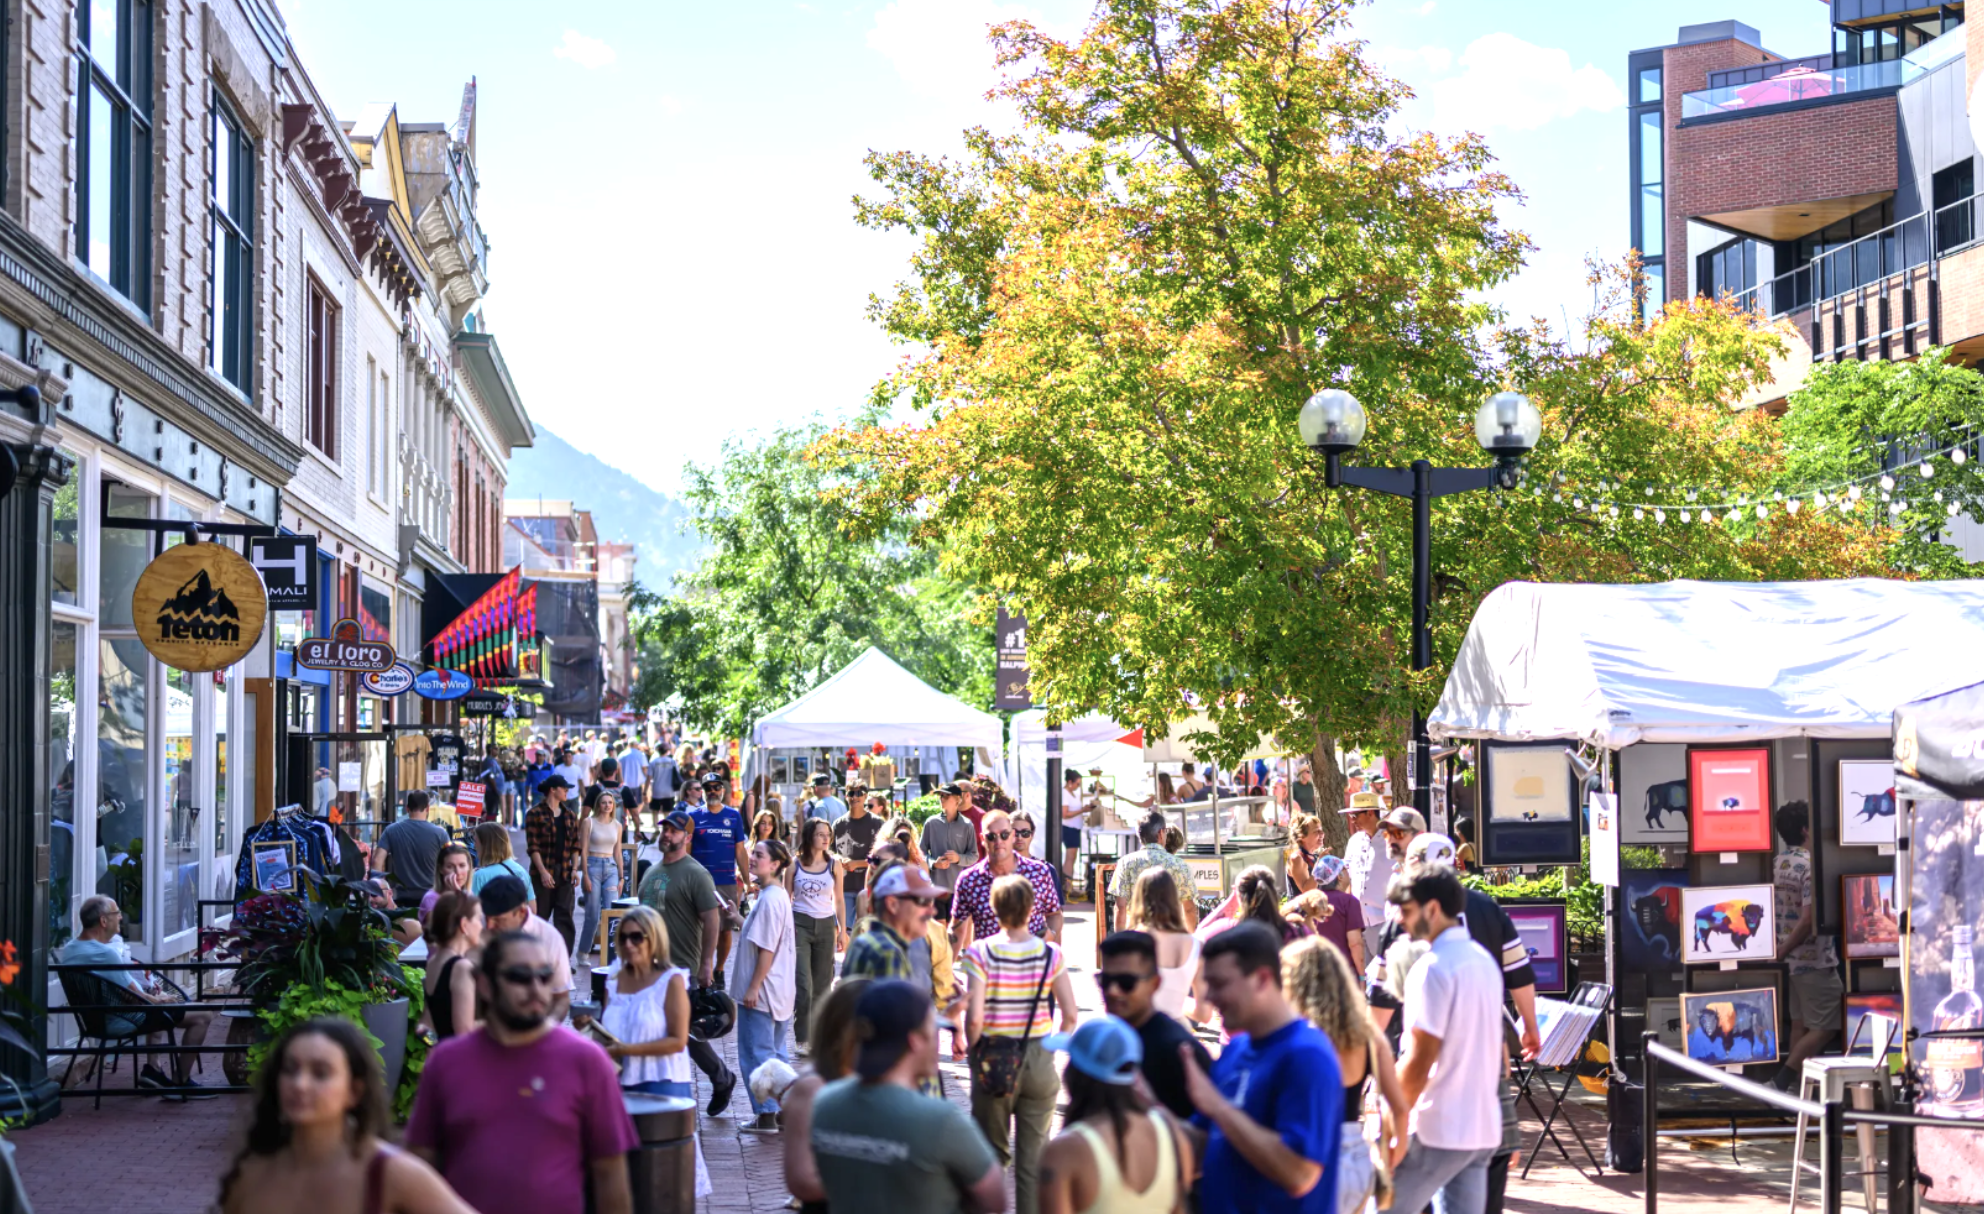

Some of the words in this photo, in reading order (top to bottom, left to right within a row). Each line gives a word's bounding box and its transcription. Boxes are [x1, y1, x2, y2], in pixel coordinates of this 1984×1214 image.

[157, 613, 240, 641] Teton
[1004, 628, 1025, 648] #1
[310, 643, 330, 658] el
[338, 644, 382, 661] loro
[307, 658, 339, 666] JEWELRY
[340, 659, 347, 667] &
[369, 672, 408, 684] Charlie's
[416, 681, 431, 689] Into
[432, 681, 446, 689] The
[447, 681, 468, 689] Wind
[460, 783, 485, 793] SALE!
